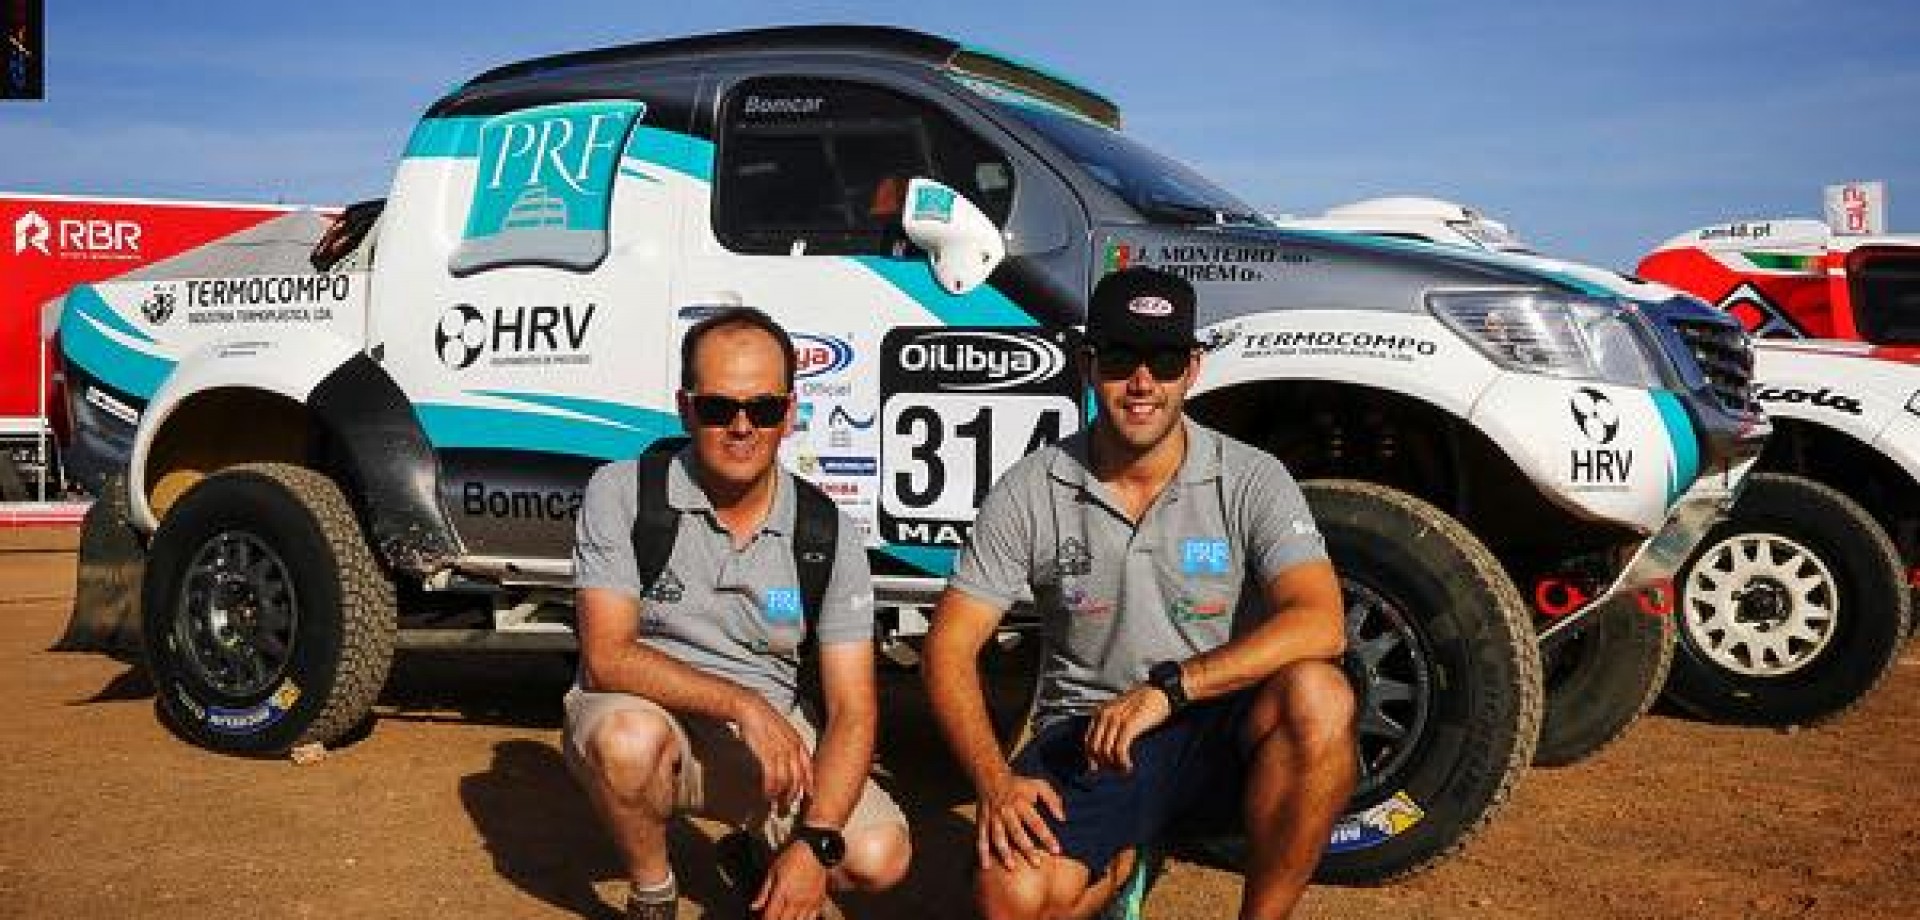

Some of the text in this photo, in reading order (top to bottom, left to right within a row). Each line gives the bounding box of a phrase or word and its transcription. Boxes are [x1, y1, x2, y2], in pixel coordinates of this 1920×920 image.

[744, 96, 825, 114] Bomcar
[489, 110, 624, 195] PRF
[60, 219, 142, 250] RBR
[1161, 245, 1278, 263] MONTEIRO
[186, 273, 350, 307] TERMOCOMPO
[491, 302, 597, 352] HRV
[1244, 331, 1438, 356] TERMOCOMPO
[1570, 448, 1633, 484] HRV
[463, 481, 584, 521] Bomca
